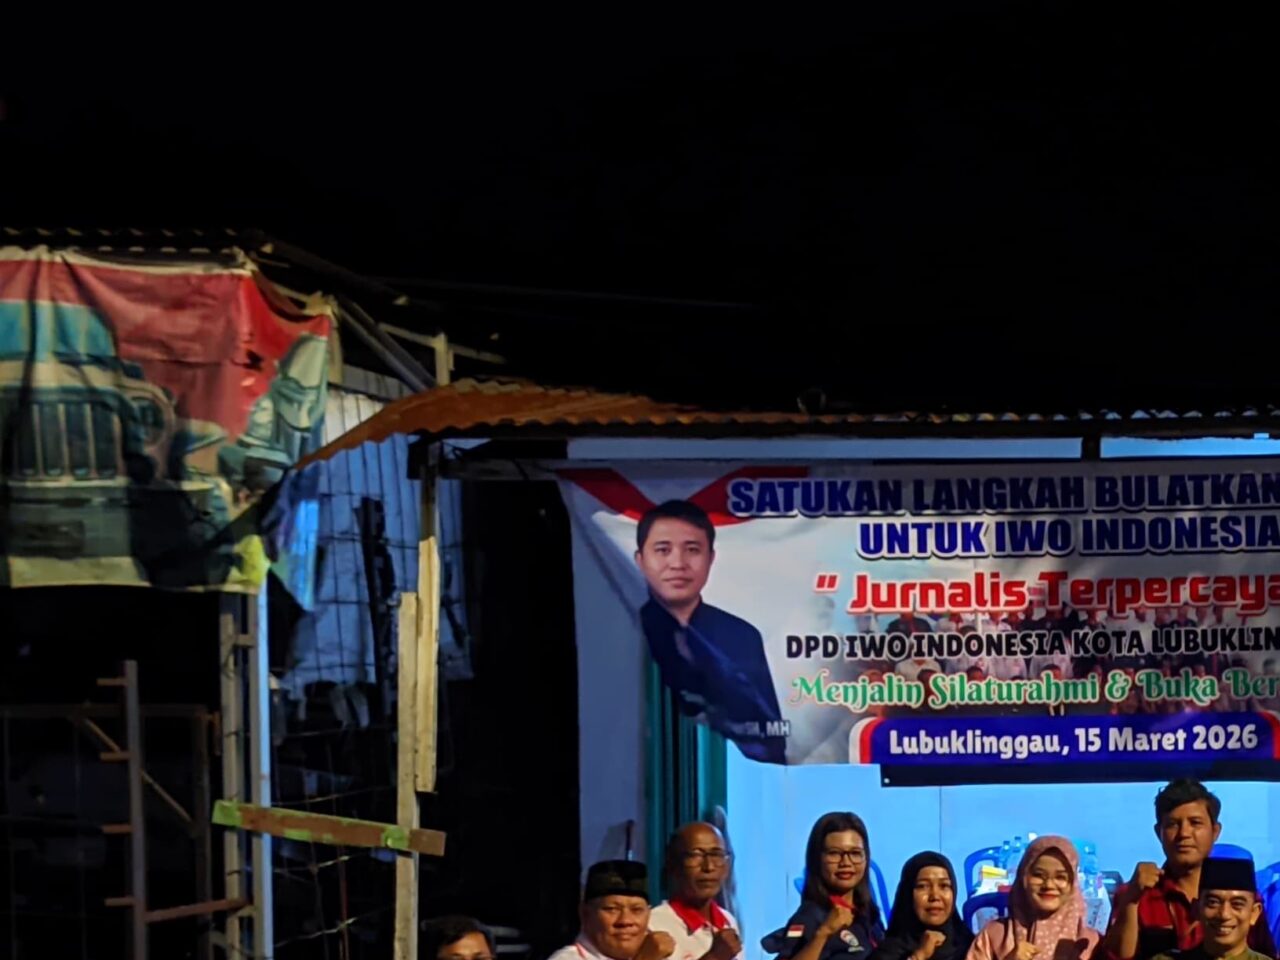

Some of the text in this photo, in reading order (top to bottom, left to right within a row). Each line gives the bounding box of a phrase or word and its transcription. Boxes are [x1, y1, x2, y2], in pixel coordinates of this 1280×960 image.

[729, 479, 902, 516] SATUKAN
[912, 477, 1085, 514] LANGKAH
[859, 521, 986, 555] UNTUK
[995, 519, 1072, 553] IWO
[850, 572, 1027, 609] Jurnalis
[786, 634, 839, 658] DPD
[846, 633, 908, 659] IWO
[912, 631, 1067, 658] INDONESIA
[1073, 629, 1146, 655] KOTA
[792, 671, 923, 713] Menjalin
[929, 671, 1098, 707] Silaturahmi
[1105, 668, 1131, 699] &
[1136, 667, 1218, 706] Buka
[889, 724, 1260, 759] Lubuklinggau, 15 Maret 2026
